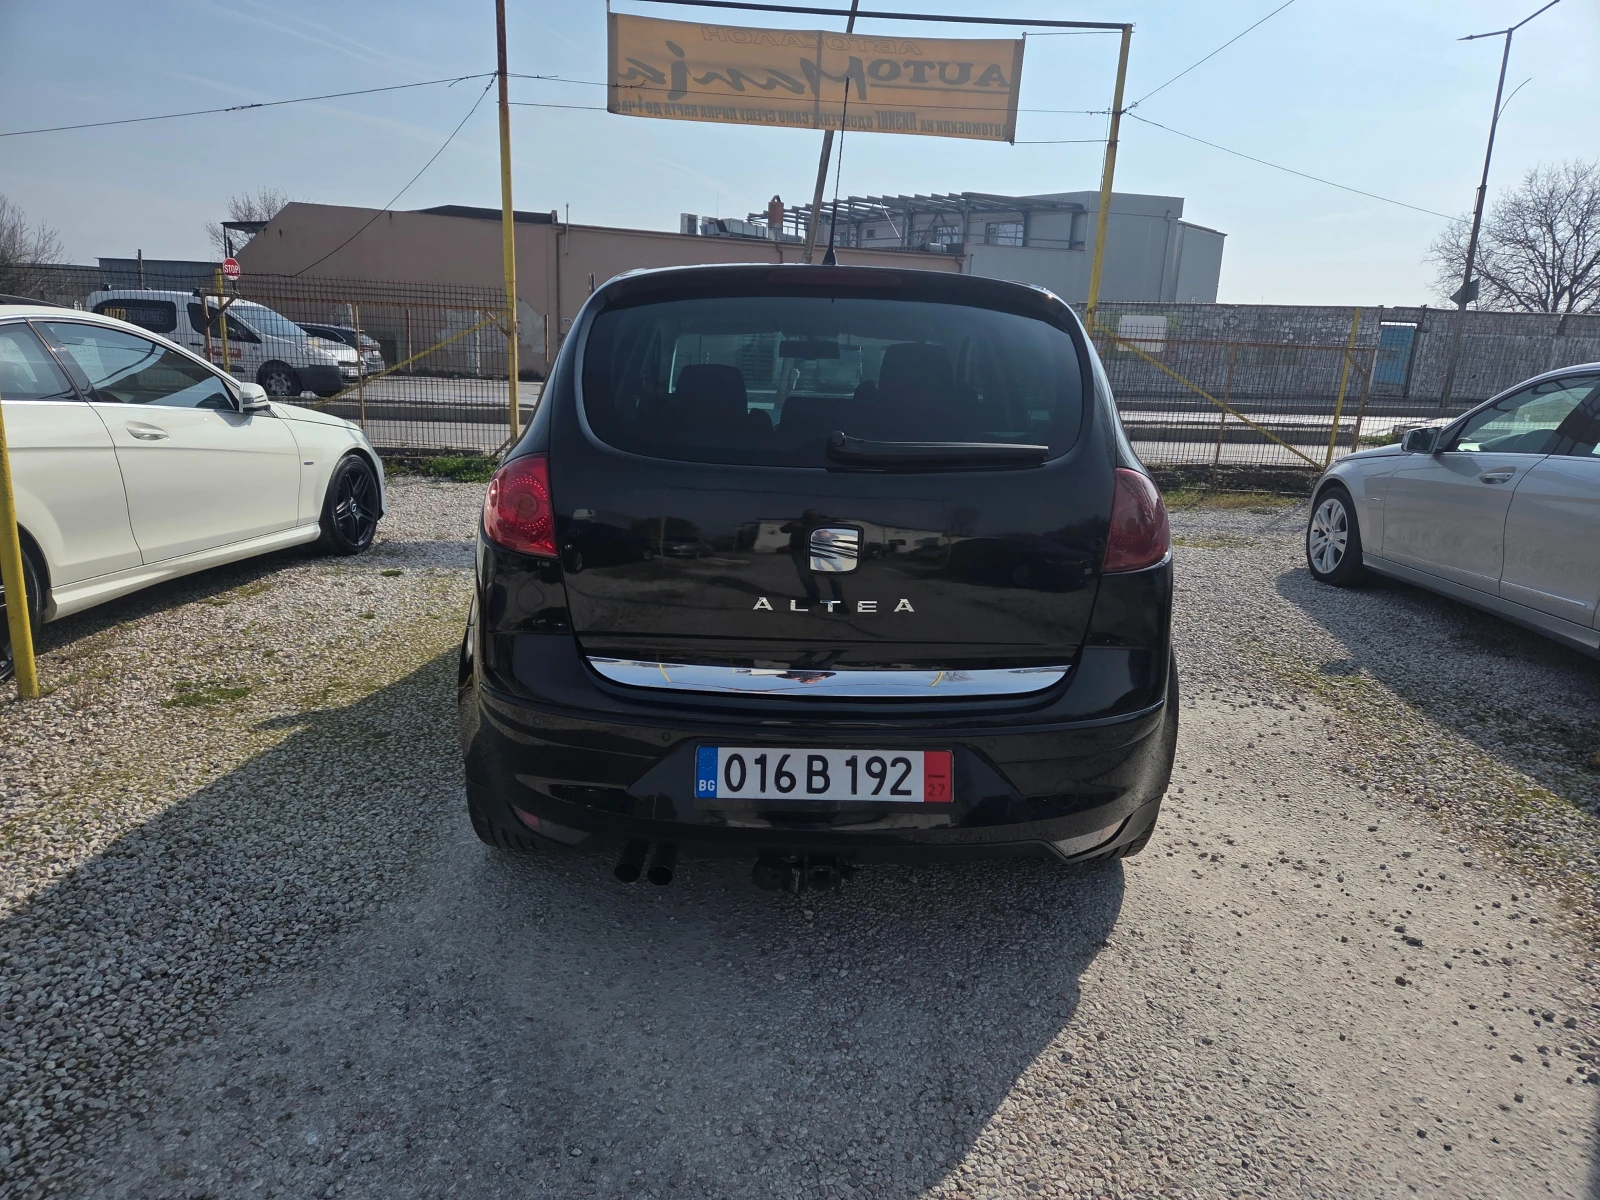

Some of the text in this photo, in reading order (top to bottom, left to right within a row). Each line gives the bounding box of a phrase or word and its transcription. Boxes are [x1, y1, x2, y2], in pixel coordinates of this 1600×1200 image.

[224, 264, 238, 273] STOP
[753, 597, 914, 613] ALTEA
[699, 780, 715, 792] BG
[928, 784, 946, 797] 27
